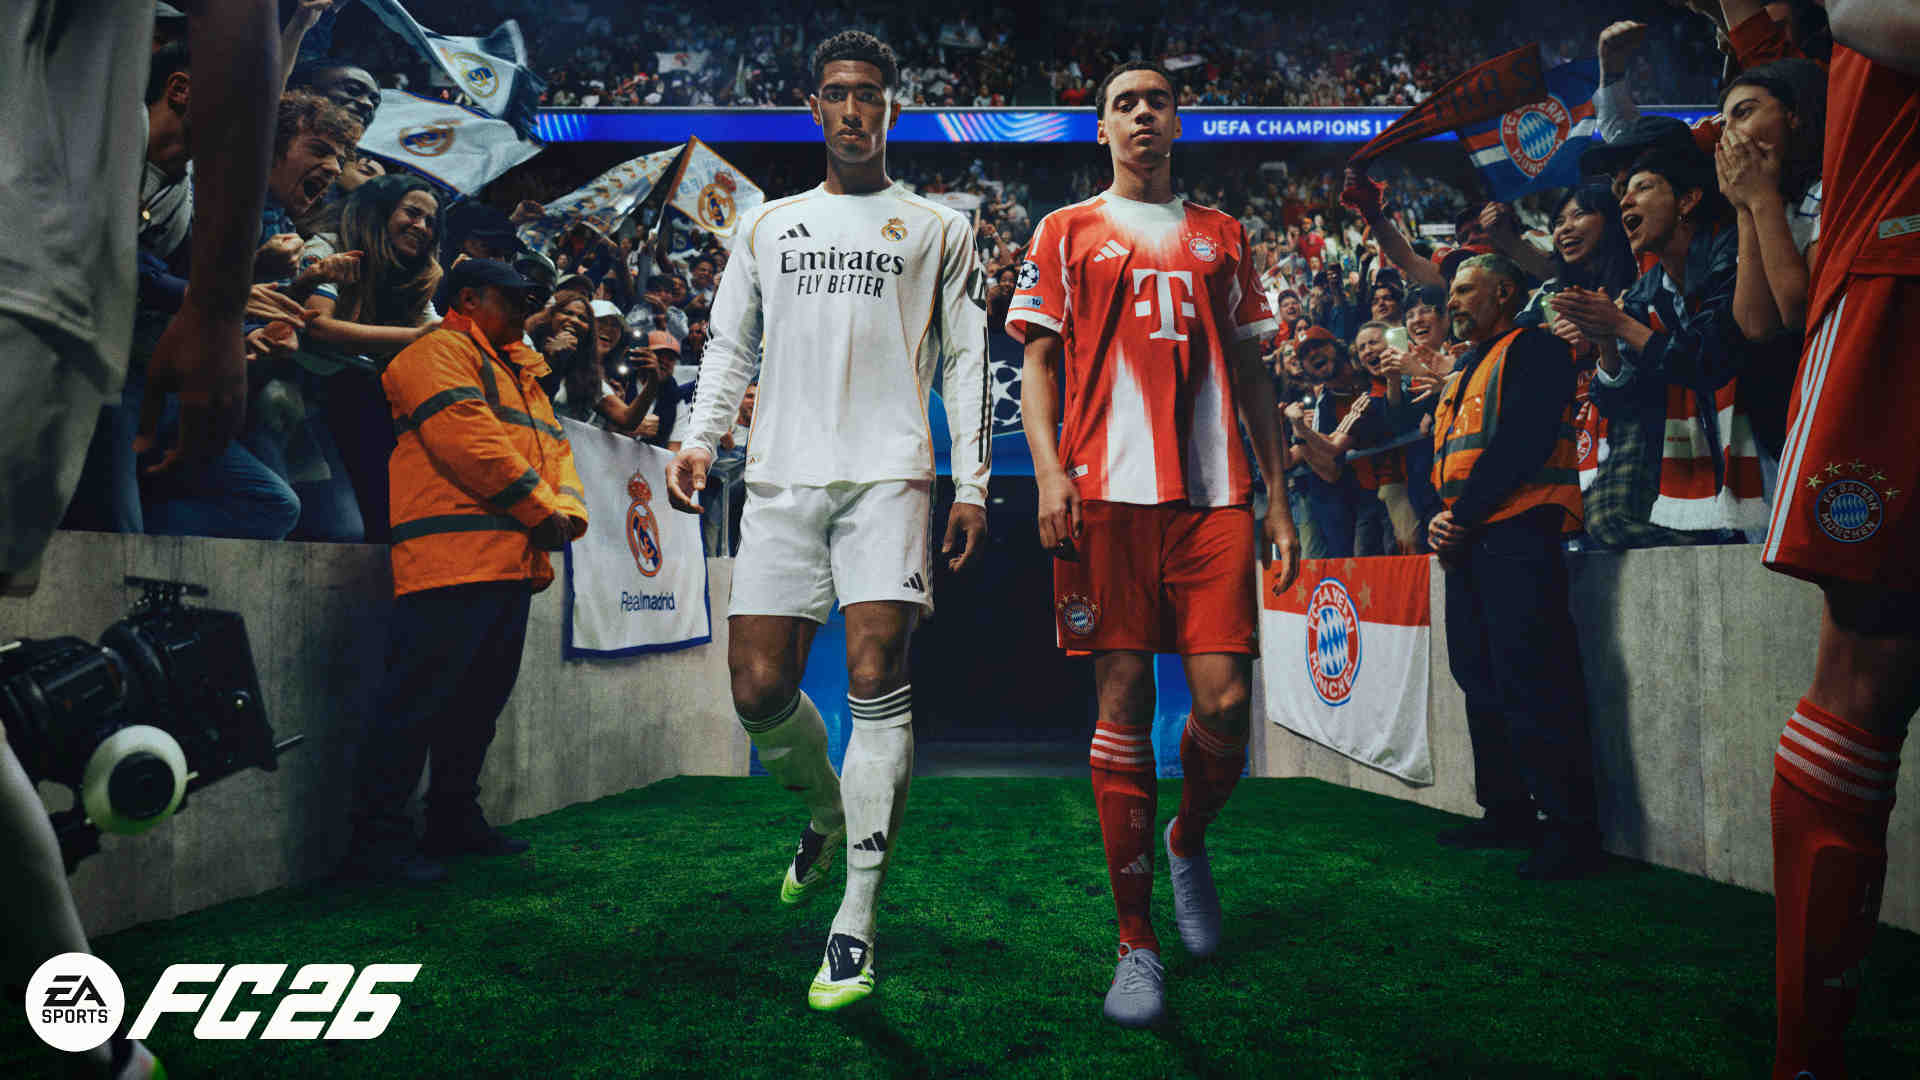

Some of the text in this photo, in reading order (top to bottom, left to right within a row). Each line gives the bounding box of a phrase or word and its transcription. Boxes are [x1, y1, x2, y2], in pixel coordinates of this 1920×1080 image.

[1203, 119, 1251, 136] UEFA
[1256, 119, 1370, 136] CHAMPIONS
[781, 247, 905, 275] Emirates
[798, 274, 884, 298] FLY BETTER
[1132, 268, 1196, 341] T
